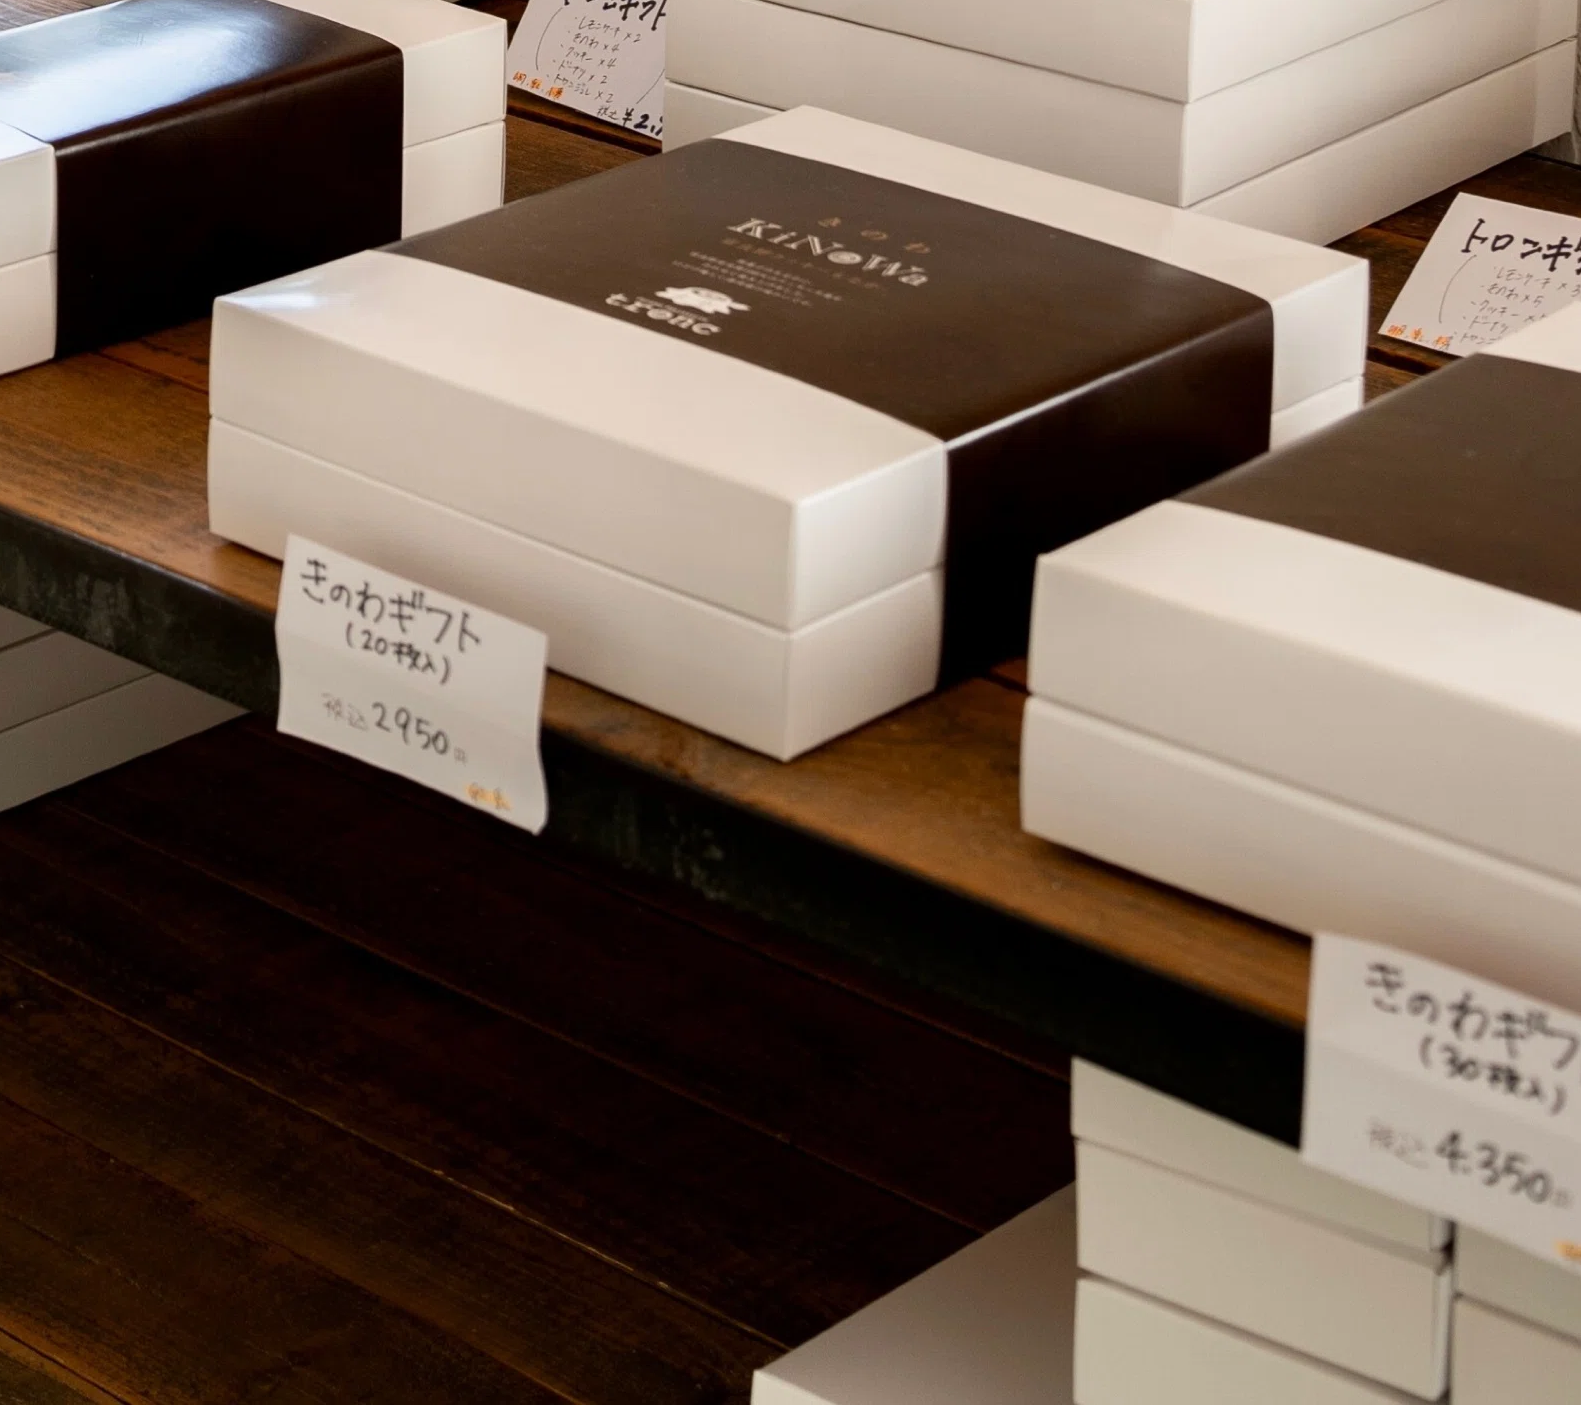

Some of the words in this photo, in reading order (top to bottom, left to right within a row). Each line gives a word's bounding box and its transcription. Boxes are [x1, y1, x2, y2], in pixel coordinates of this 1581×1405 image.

[605, 293, 722, 336] tronc
[300, 558, 481, 653] きのわギフト
[346, 621, 452, 685] (20枚入)
